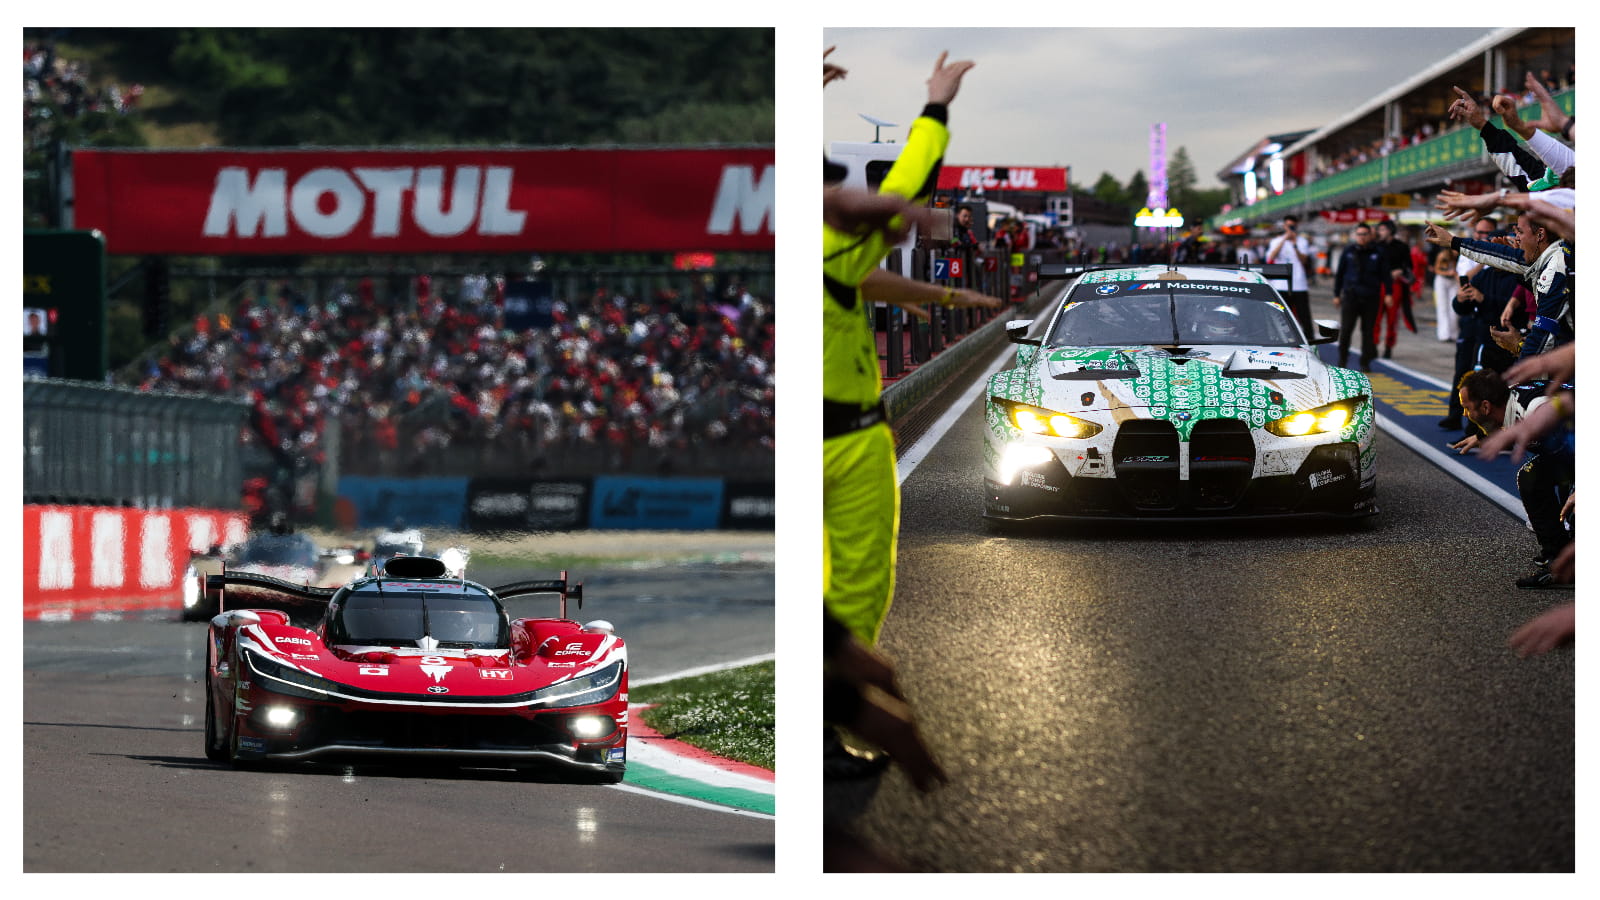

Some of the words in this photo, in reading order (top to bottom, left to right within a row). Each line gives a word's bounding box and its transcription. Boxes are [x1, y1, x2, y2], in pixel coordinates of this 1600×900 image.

[203, 166, 528, 238] MOTUL
[706, 164, 775, 235] M
[935, 262, 945, 276] 7
[951, 261, 960, 274] 8
[1167, 282, 1251, 294] Motorsport
[275, 636, 312, 646] CASIO
[420, 656, 447, 665] 8
[482, 670, 508, 678] HY
